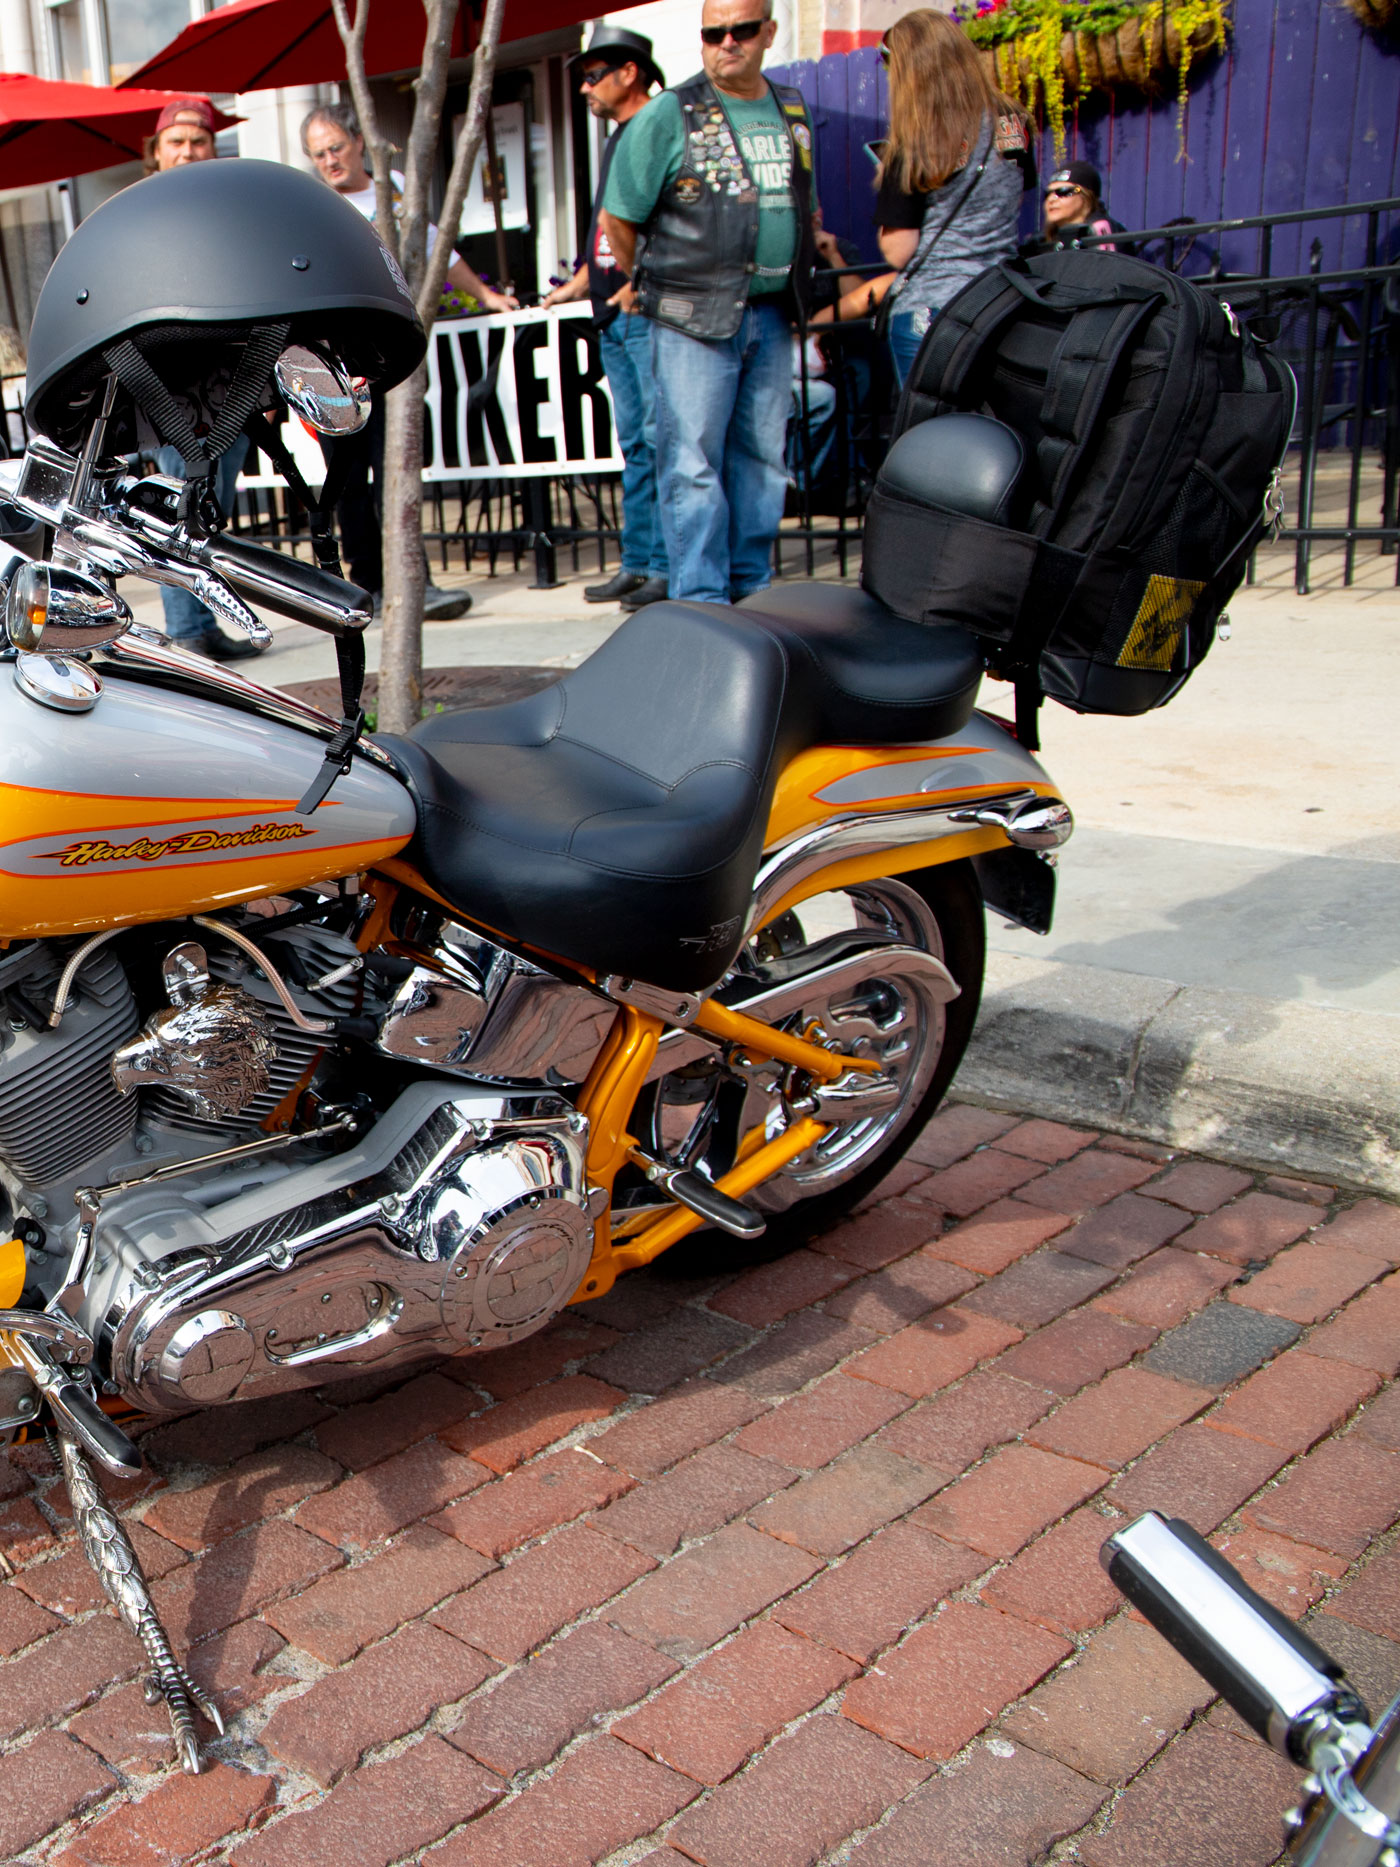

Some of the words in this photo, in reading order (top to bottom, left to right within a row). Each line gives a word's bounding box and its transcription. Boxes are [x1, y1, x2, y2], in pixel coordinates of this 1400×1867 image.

[740, 134, 792, 161] ARLE
[423, 317, 614, 469] IKER
[59, 822, 311, 867] Harley-Davidson
